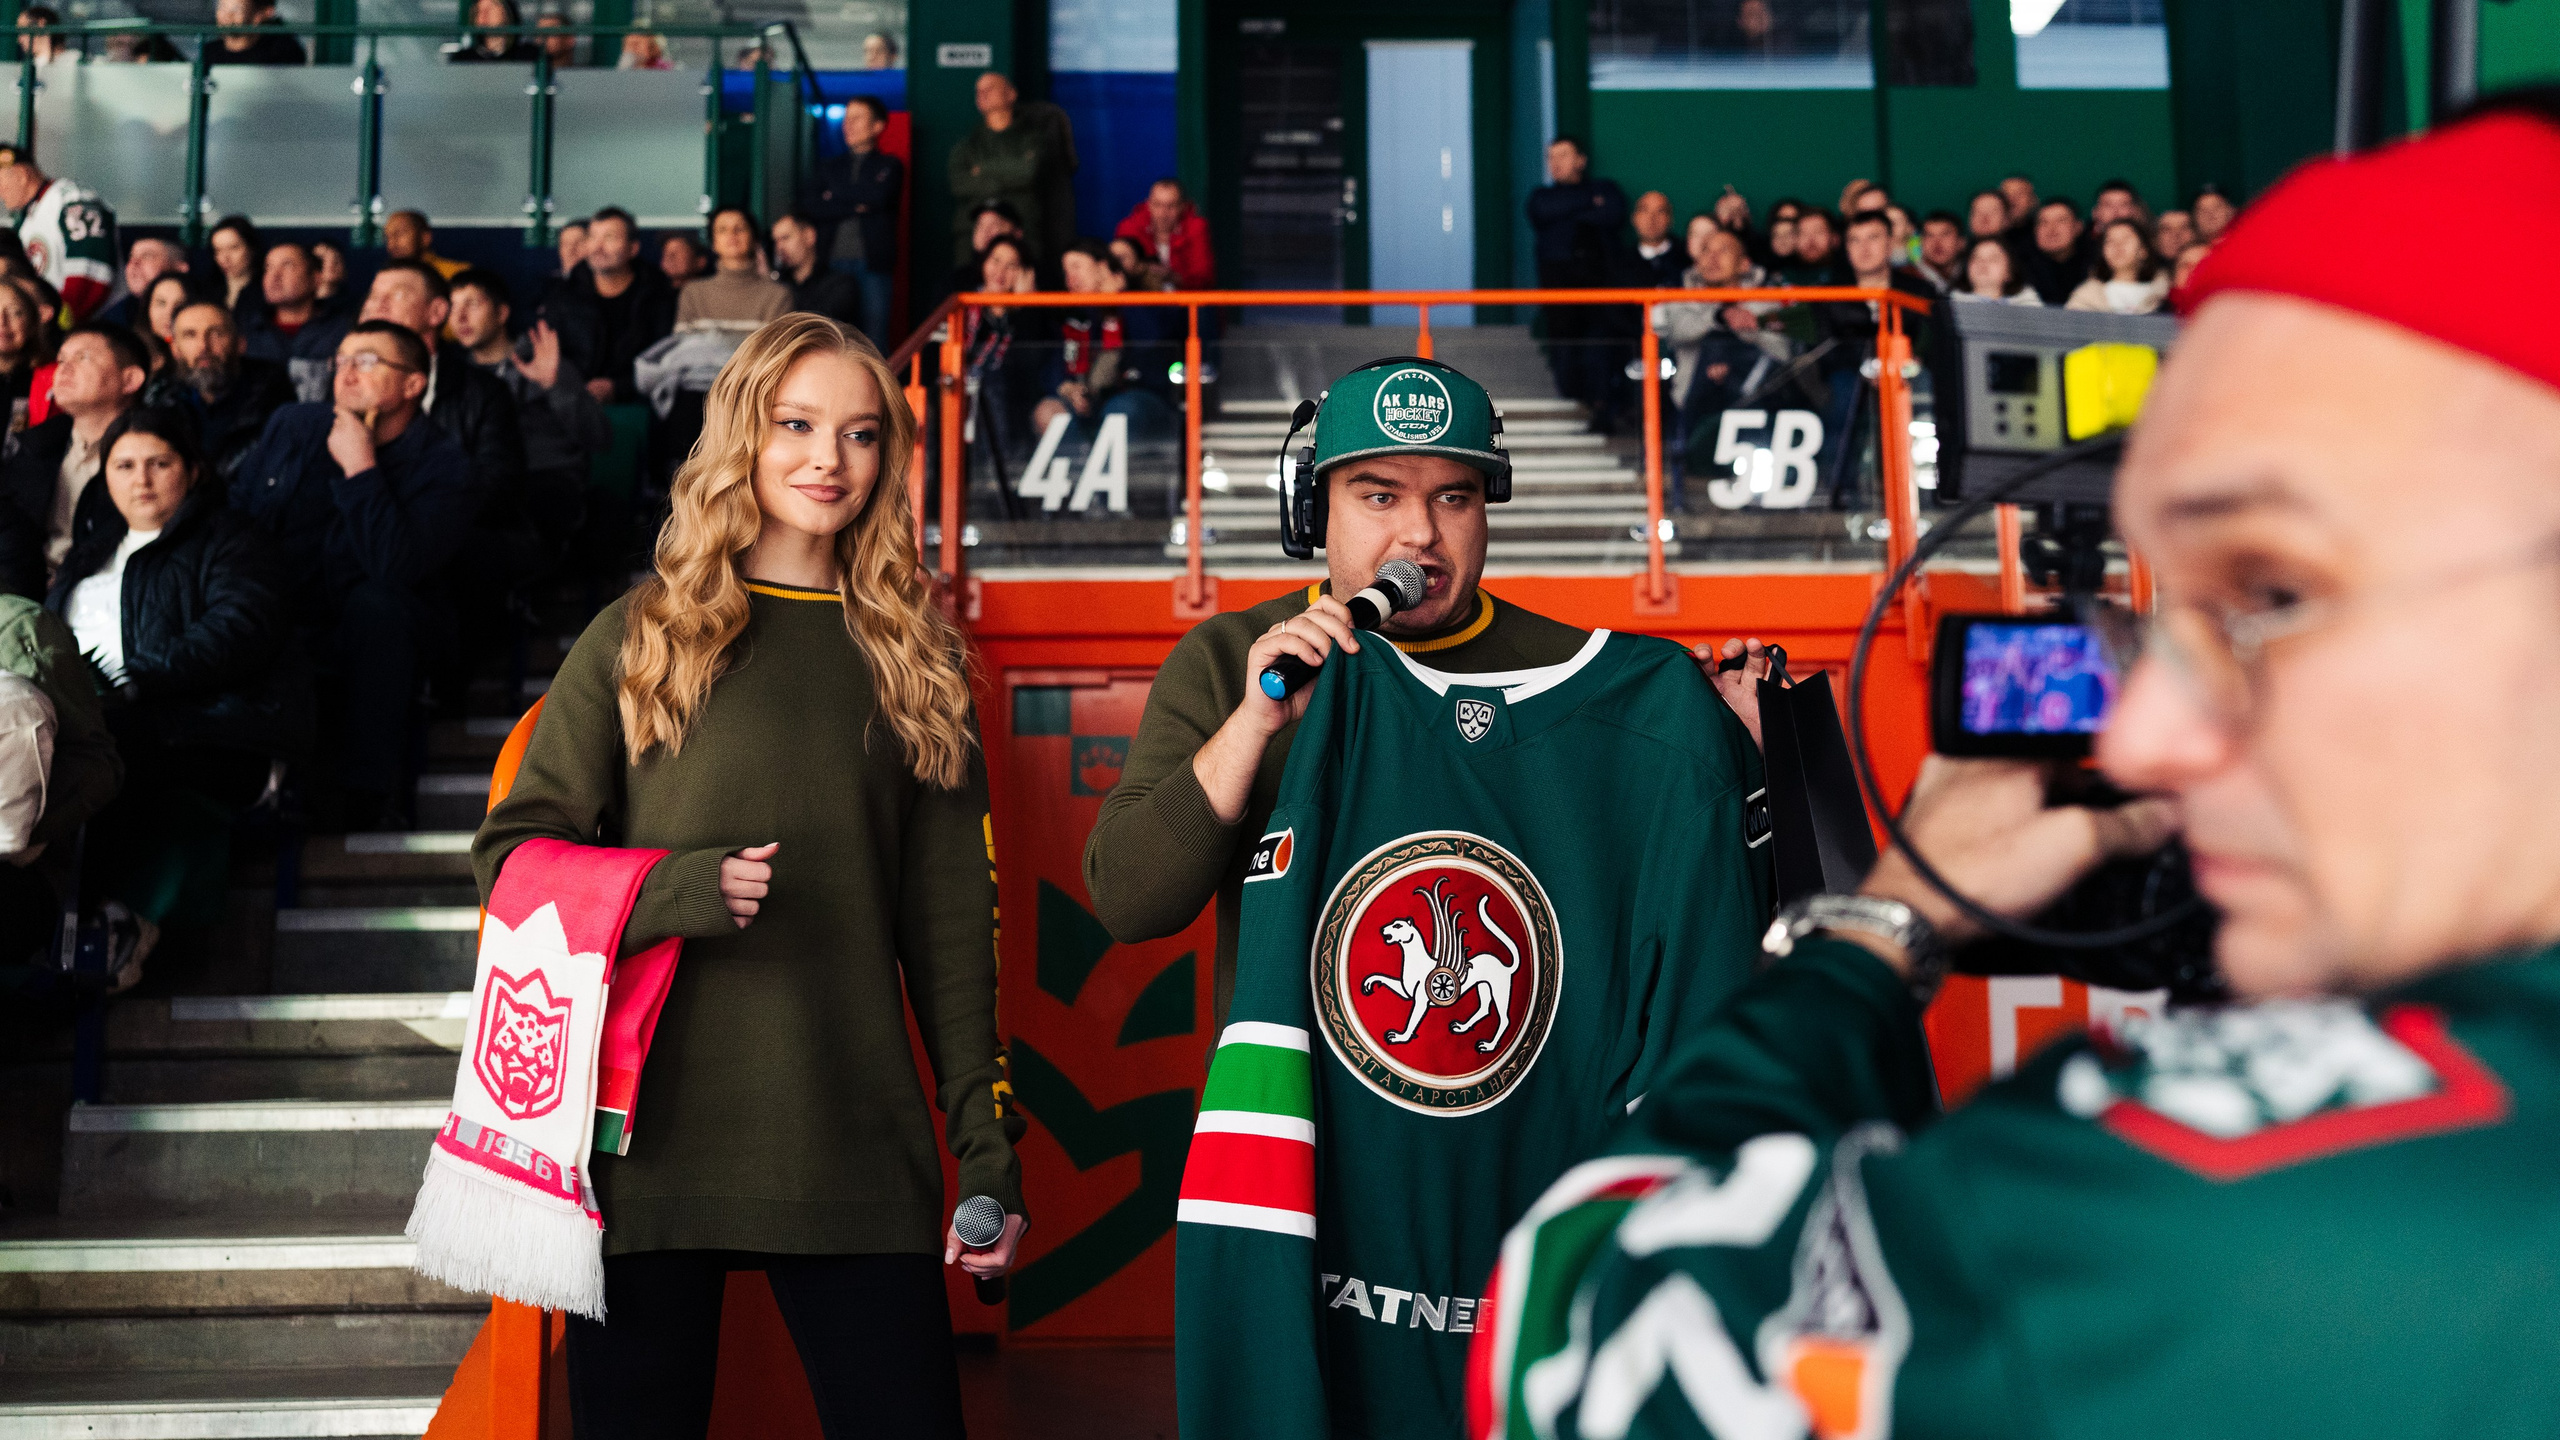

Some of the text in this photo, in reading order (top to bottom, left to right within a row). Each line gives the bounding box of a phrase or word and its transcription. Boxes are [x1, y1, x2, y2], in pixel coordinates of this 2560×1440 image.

[1397, 373, 1430, 382] KAZAN
[1382, 393, 1446, 410] AK BARS
[1385, 407, 1441, 422] HOCKEY
[1383, 421, 1428, 440] ESTABLISHED
[1018, 412, 1128, 511] 4A
[1707, 408, 1824, 510] 5B
[1366, 1060, 1501, 1106] ТАТАРСТАН
[482, 1130, 554, 1181] 1956
